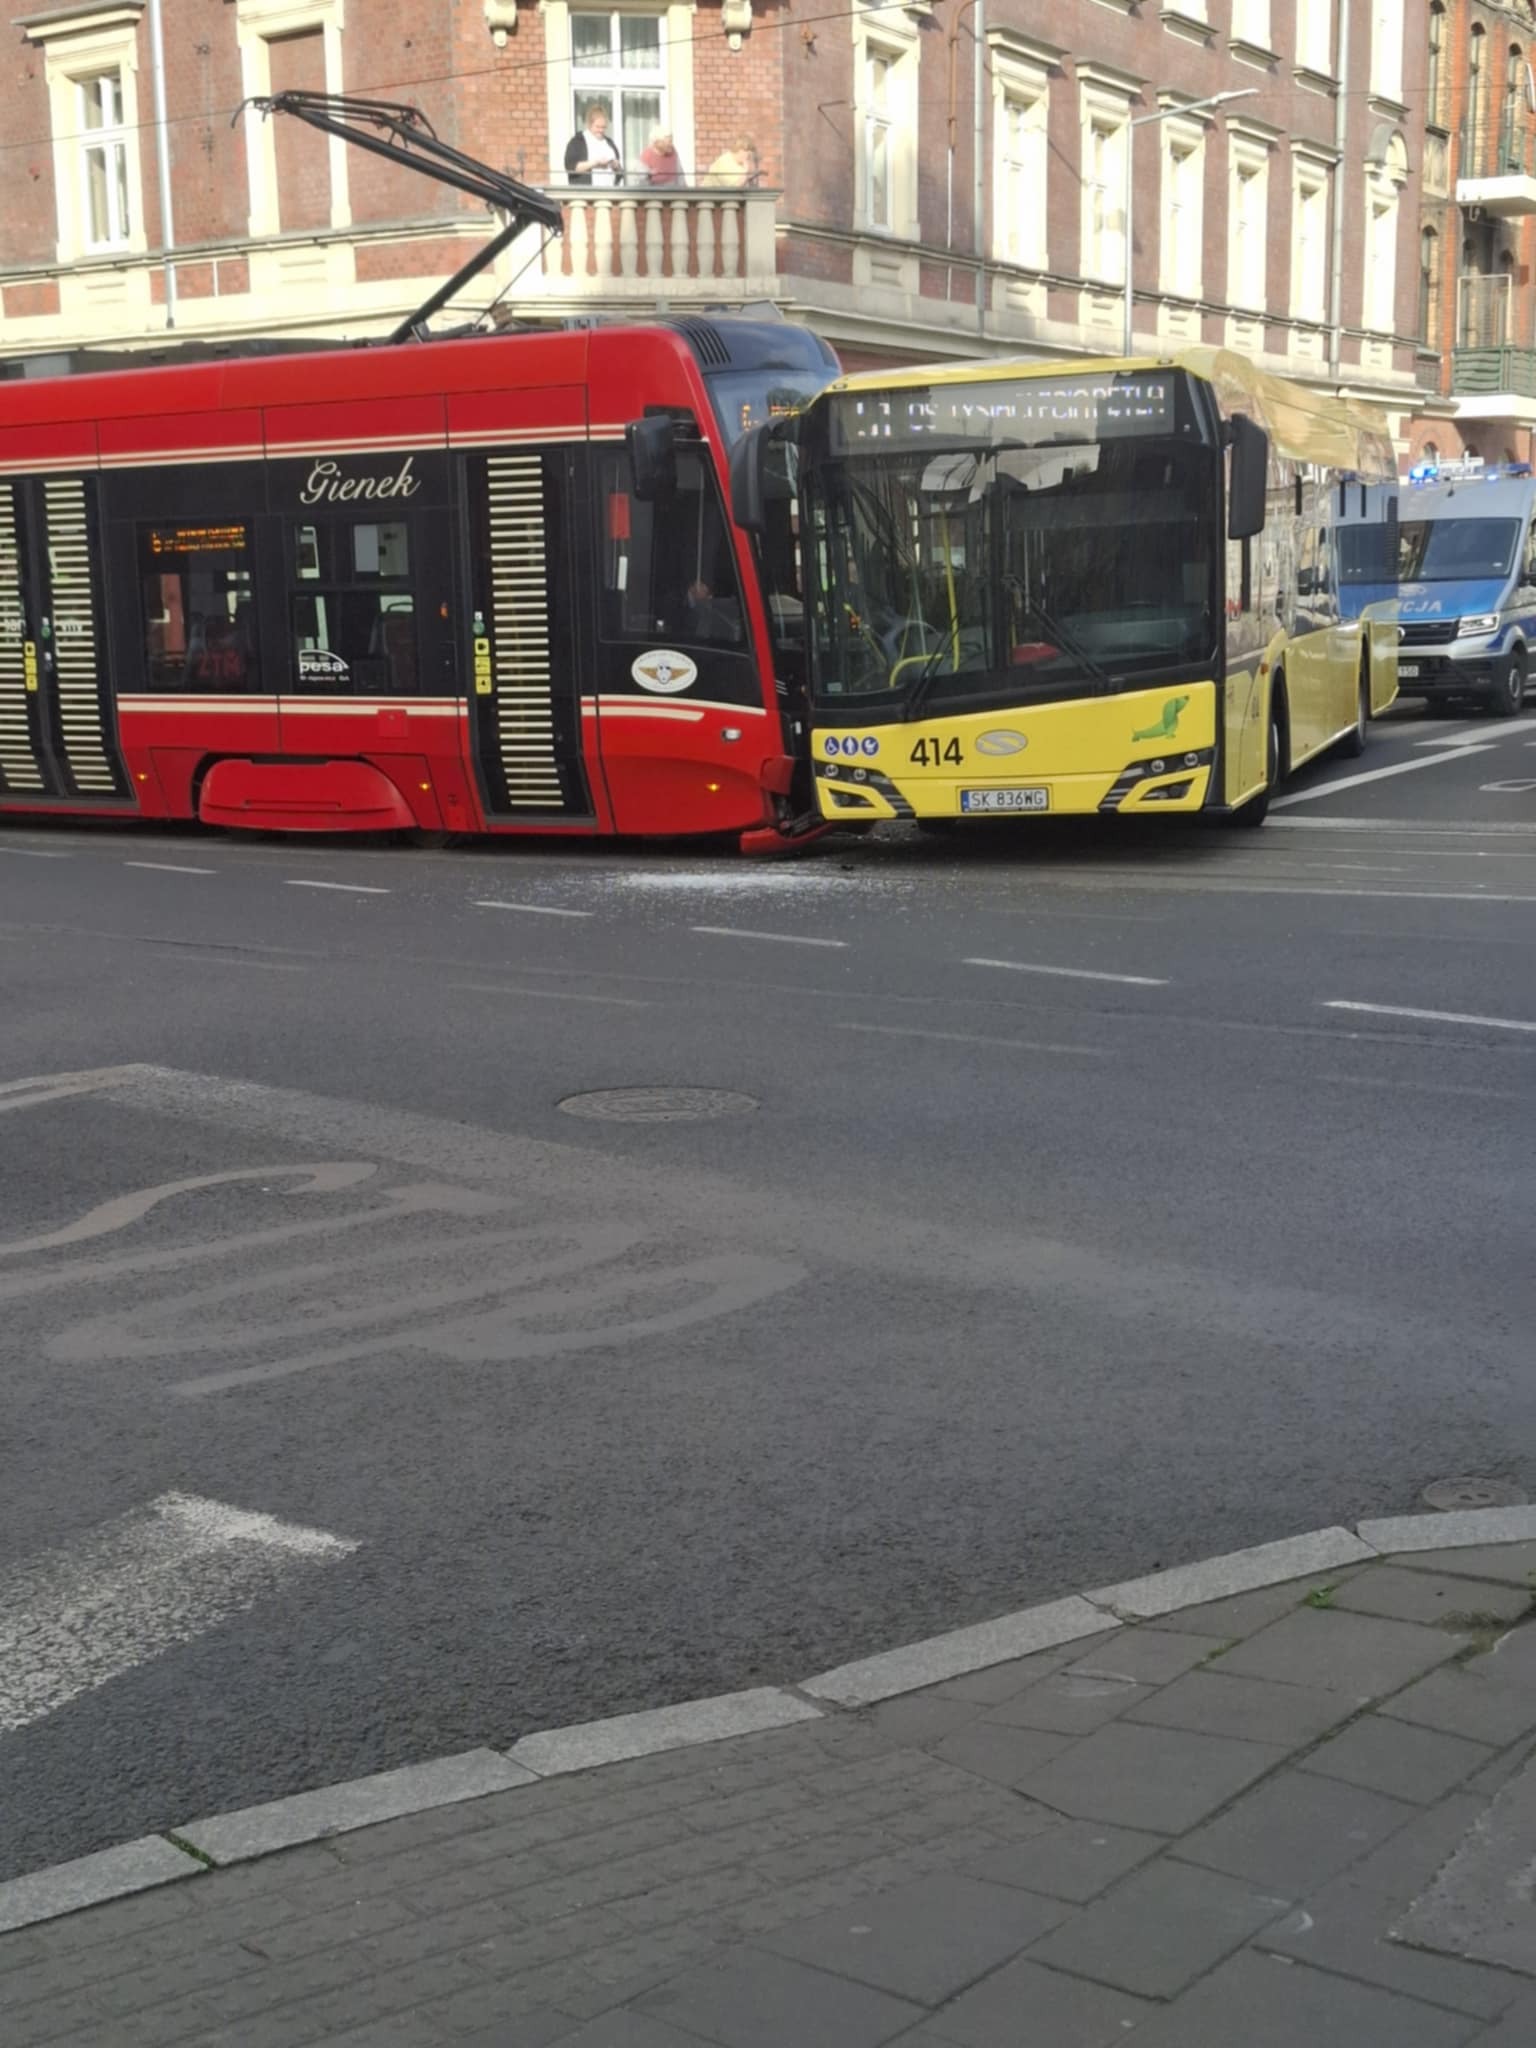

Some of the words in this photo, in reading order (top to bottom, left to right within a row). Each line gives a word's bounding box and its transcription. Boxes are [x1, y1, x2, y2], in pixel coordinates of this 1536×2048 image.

[300, 456, 421, 504] Gienek
[299, 661, 343, 674] pesa
[910, 737, 963, 767] 414
[971, 792, 990, 806] SK
[997, 790, 1044, 806] 836WG
